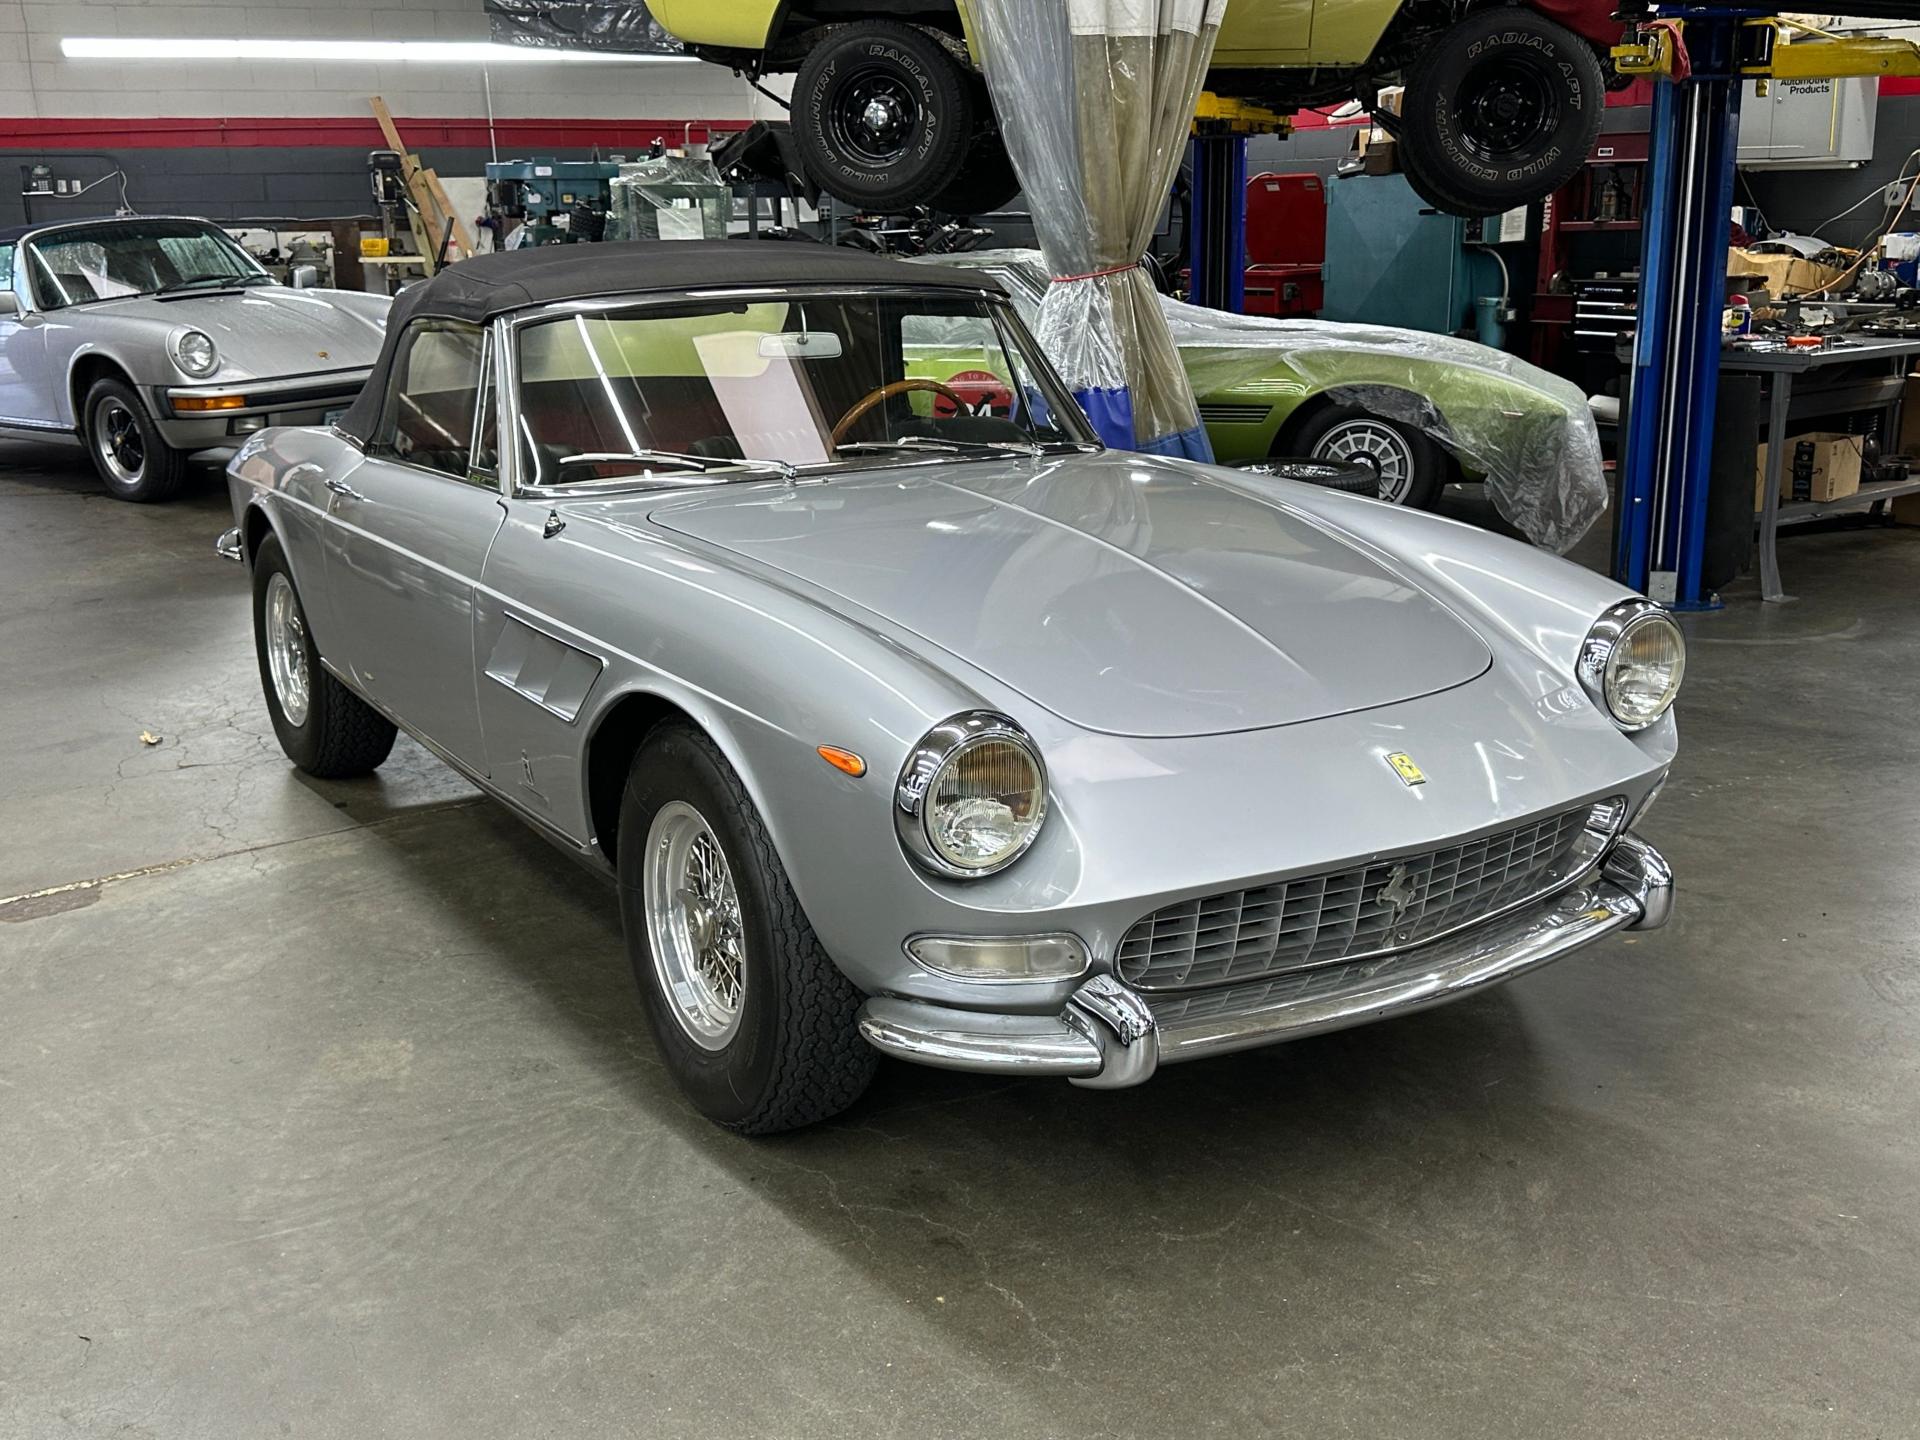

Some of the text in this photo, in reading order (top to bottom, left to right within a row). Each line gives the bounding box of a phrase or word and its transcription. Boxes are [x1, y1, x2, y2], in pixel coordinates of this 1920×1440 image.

[869, 44, 936, 160] RADIAL APT
[1467, 32, 1582, 110] RADIAL APT
[1790, 85, 1830, 94] Products
[810, 60, 889, 183] WILD COUNTRY
[1435, 91, 1561, 181] WILD COUNTRY
